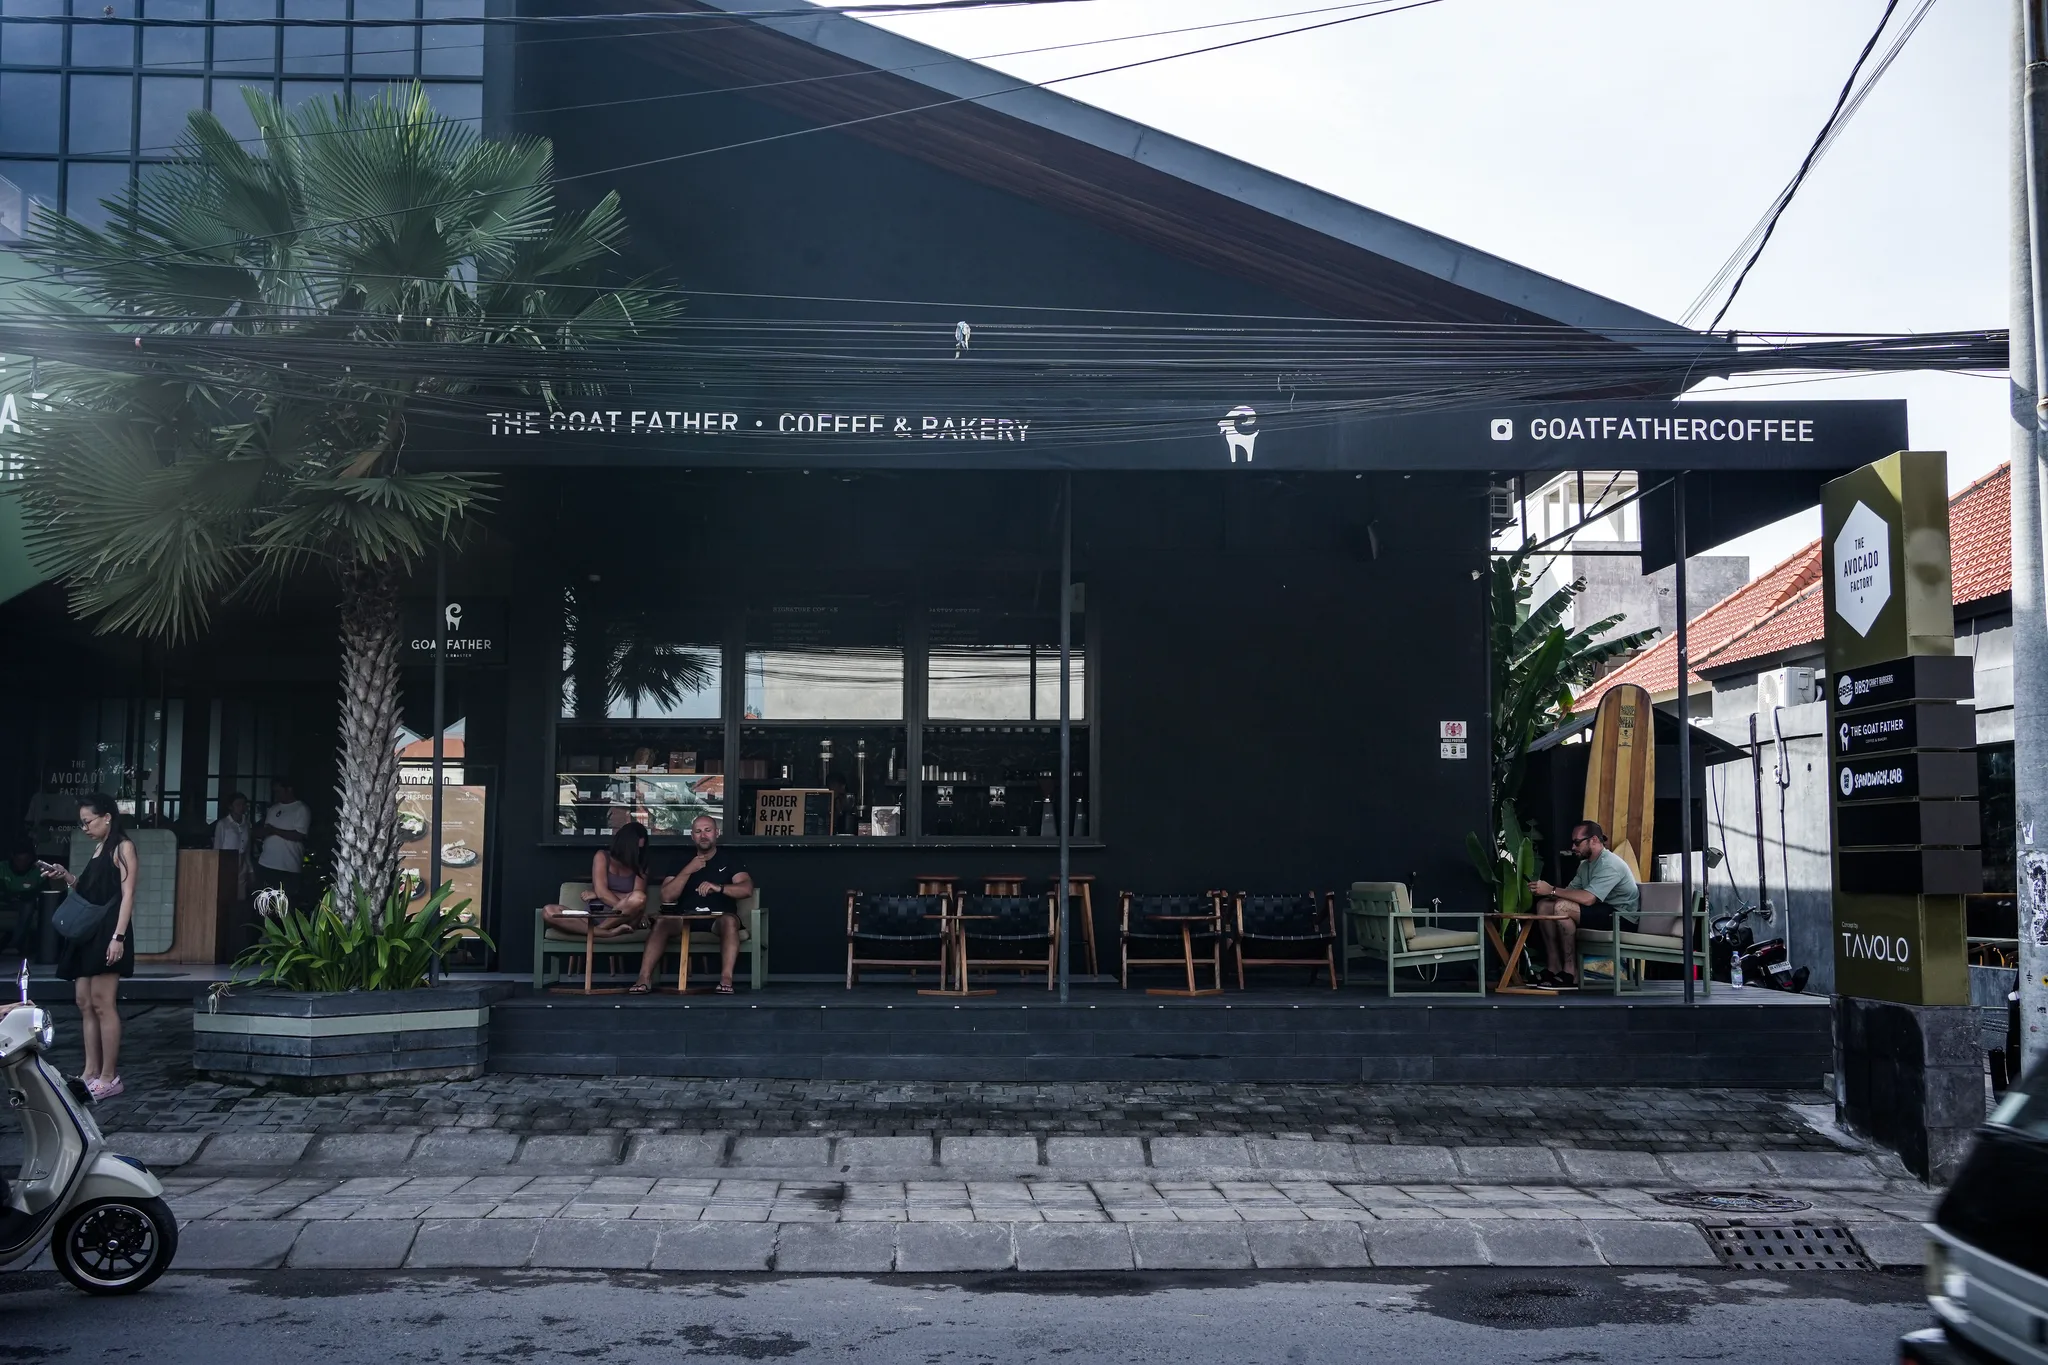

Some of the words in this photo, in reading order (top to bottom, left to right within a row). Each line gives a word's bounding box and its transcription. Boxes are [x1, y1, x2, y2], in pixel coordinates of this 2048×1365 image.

[486, 411, 540, 435] THE
[550, 411, 622, 434] GOAT
[631, 411, 739, 434] FATHER
[779, 412, 885, 435] COFFEE
[893, 416, 912, 438] &
[922, 416, 1031, 441] BAKERY
[1530, 417, 1814, 442] GOATFATHERCOFFEE
[1855, 537, 1865, 550] THE
[1844, 550, 1879, 577] AVOCADO
[1851, 575, 1873, 592] FACTORY
[411, 639, 437, 650] GOA
[446, 639, 492, 650] FATHER
[1854, 679, 1870, 695] BB52
[1851, 725, 1862, 736] THE
[1862, 722, 1879, 735] GOAT
[1880, 718, 1904, 732] FATHER
[71, 760, 86, 768] THE
[50, 772, 106, 784] AVOCADO
[400, 776, 450, 784] VOCAO
[60, 787, 95, 796] FACTORY
[761, 795, 797, 807] ORDER
[760, 809, 767, 821] &
[770, 809, 793, 821] PAY
[765, 825, 795, 835] HERE
[1842, 933, 1908, 963] TAVOLO
